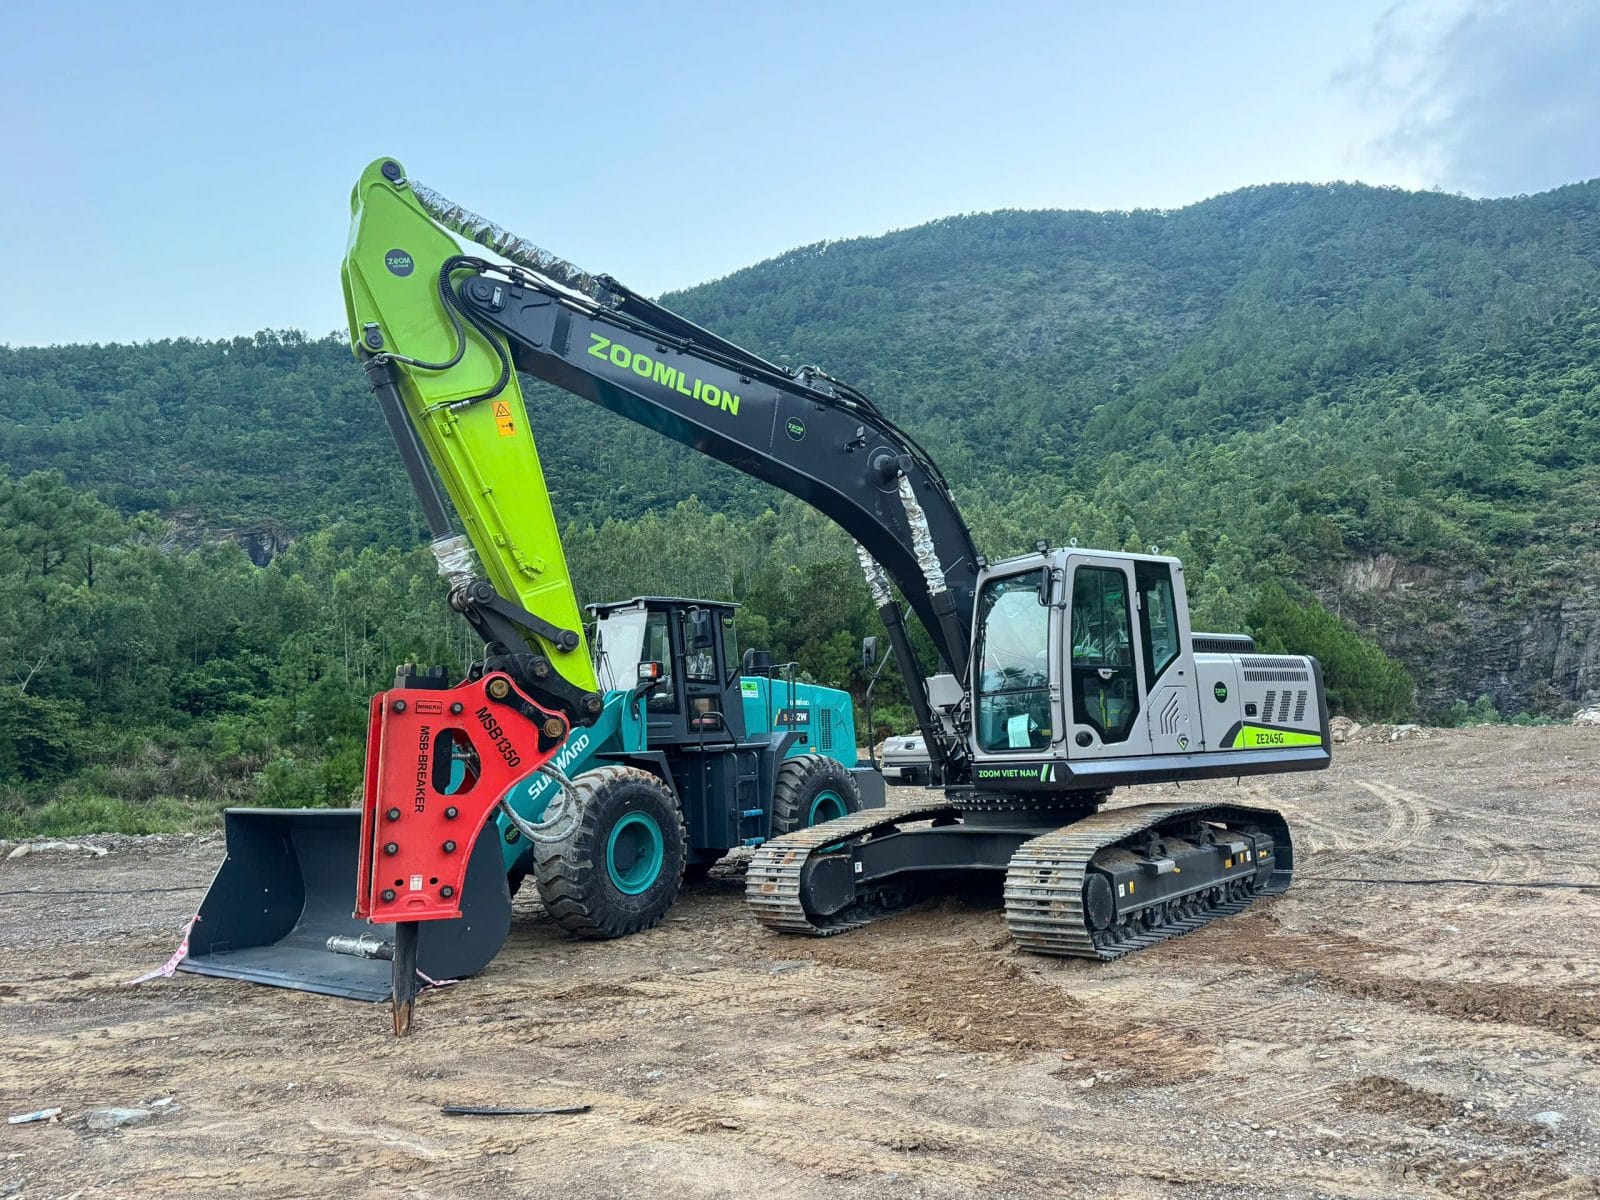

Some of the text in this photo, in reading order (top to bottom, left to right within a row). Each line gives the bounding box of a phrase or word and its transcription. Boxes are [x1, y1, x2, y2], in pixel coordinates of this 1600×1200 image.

[587, 332, 740, 416] ZOOMLION
[475, 706, 520, 767] MSB1350
[1256, 733, 1284, 744] ZE245G
[414, 725, 430, 813] MSB-BREAKER
[978, 769, 1038, 778] ZOOM VIET NAM
